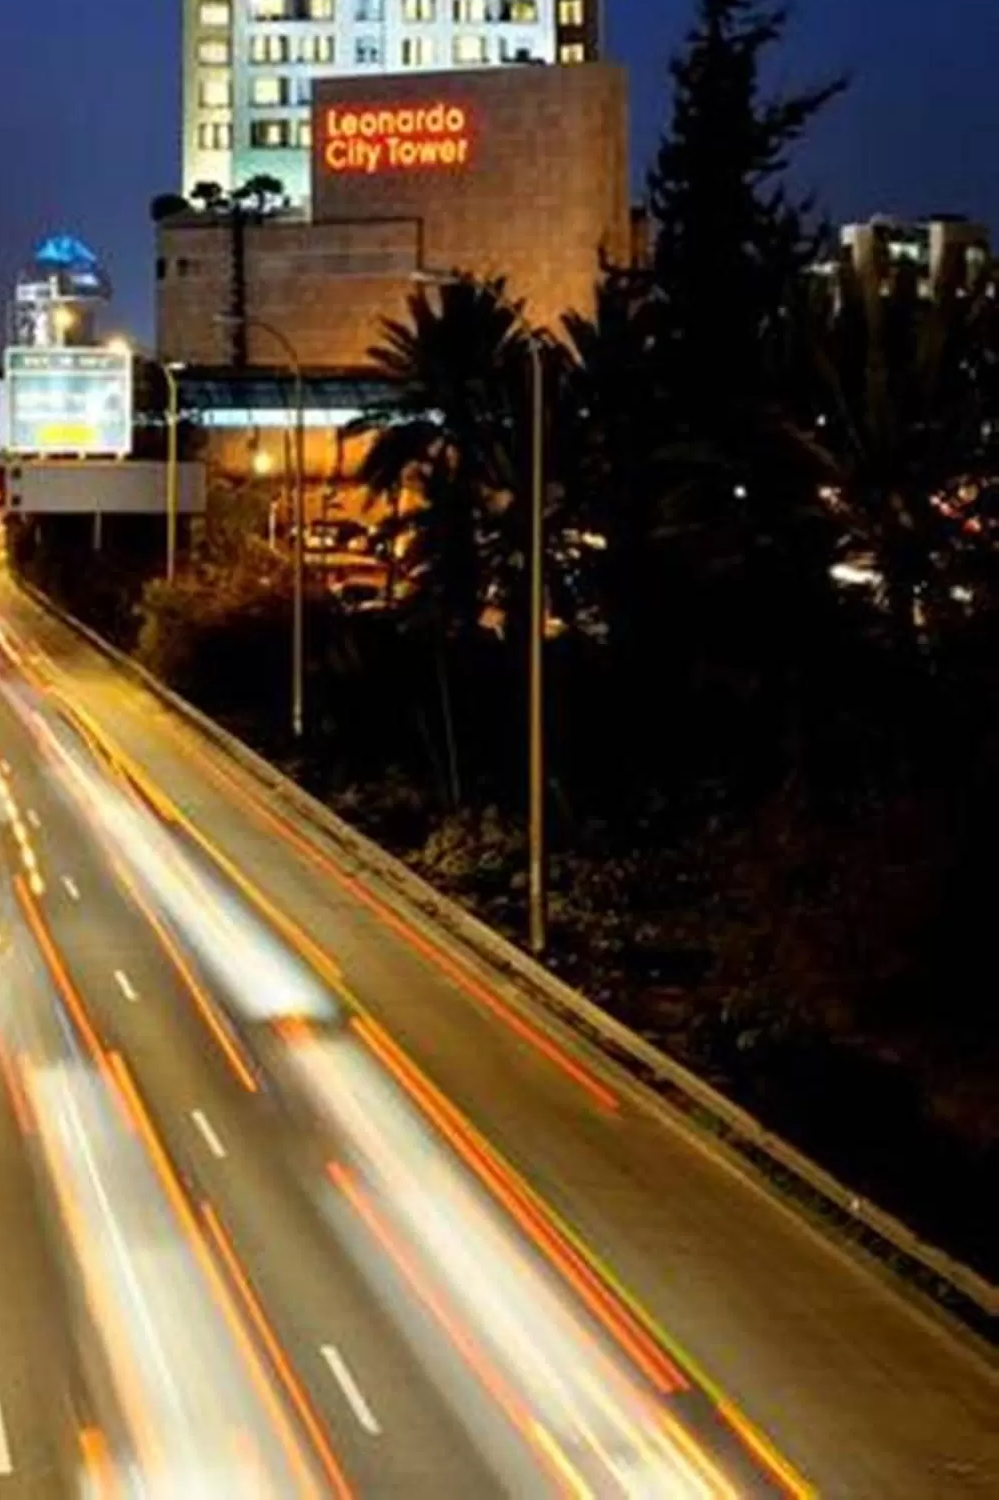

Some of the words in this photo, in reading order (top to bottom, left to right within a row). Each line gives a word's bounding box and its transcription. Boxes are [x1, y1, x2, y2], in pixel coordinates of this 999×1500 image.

[327, 103, 465, 137] Leonardo
[325, 139, 381, 174] City
[387, 137, 468, 166] Tower
